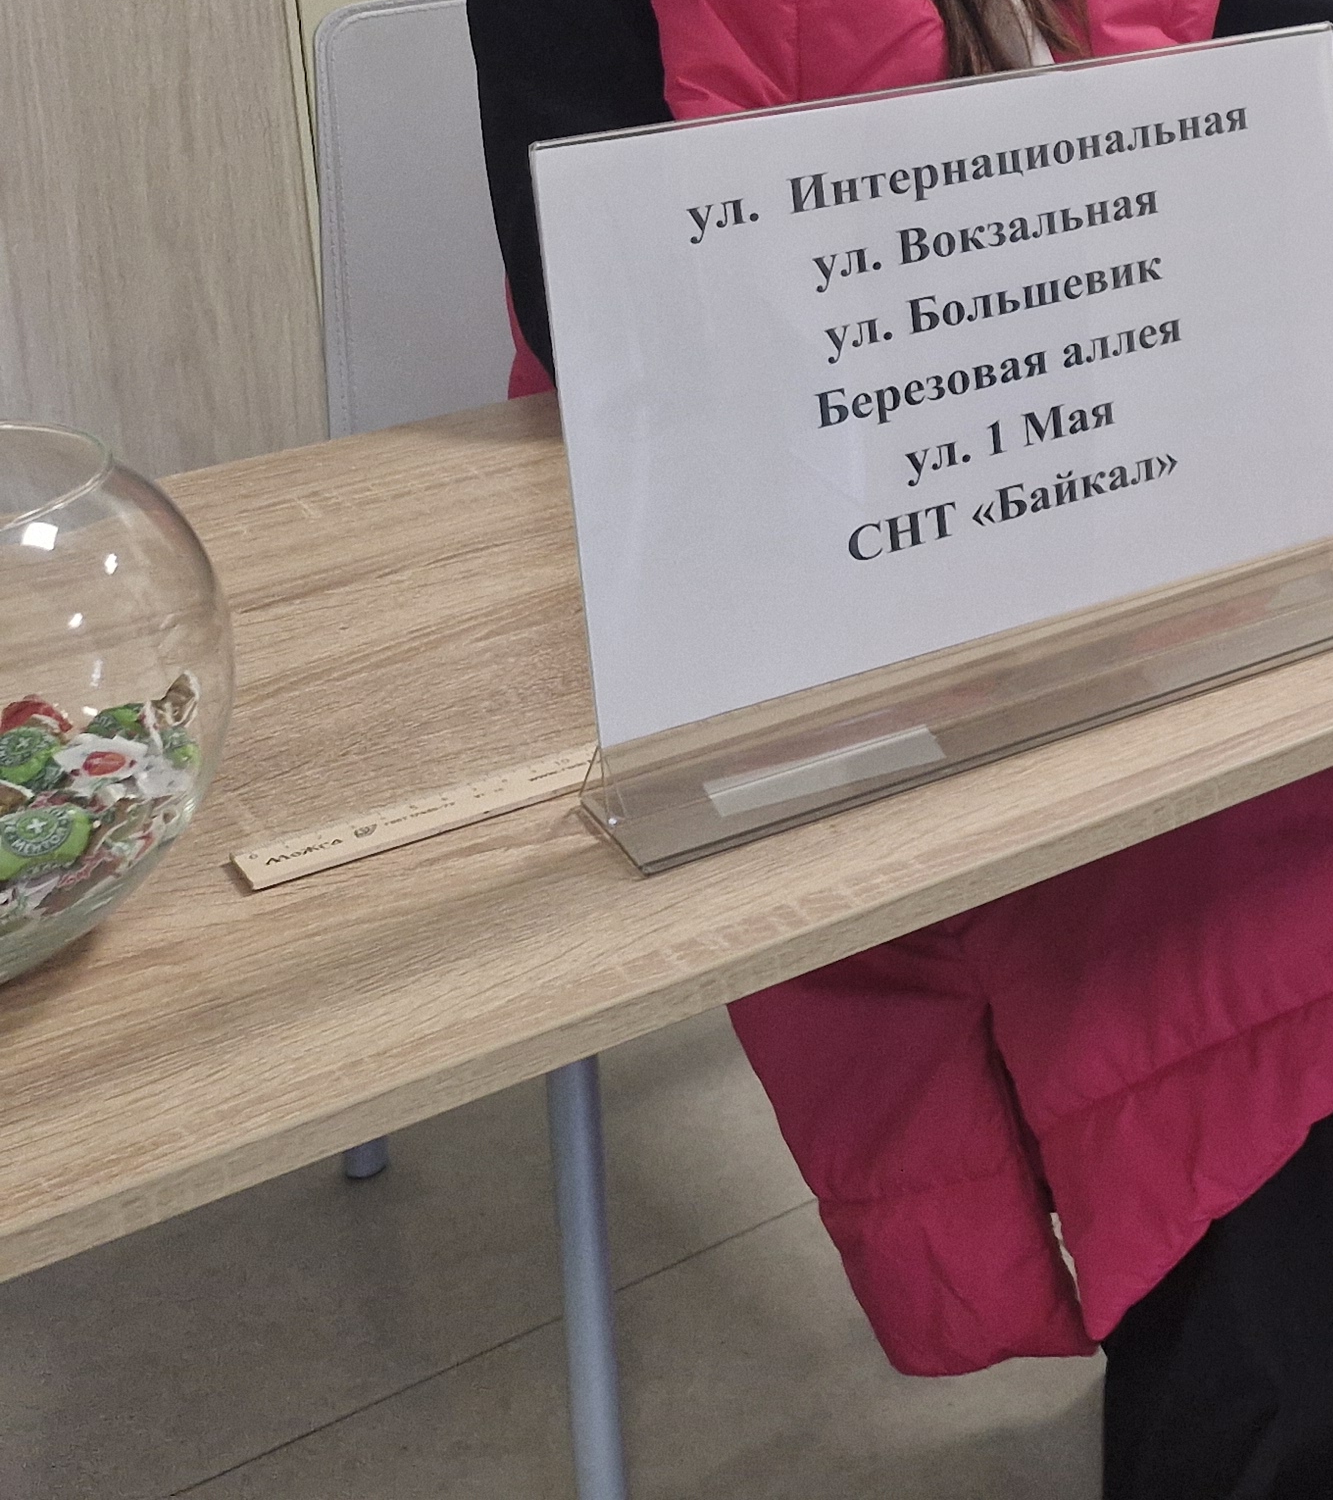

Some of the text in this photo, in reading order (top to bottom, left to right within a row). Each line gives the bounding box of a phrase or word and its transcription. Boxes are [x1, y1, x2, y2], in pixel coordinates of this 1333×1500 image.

[685, 107, 1249, 245] ул. Интернациональная
[811, 190, 1160, 293] ул. Вокзальная
[823, 255, 1164, 365] ул. Большевик
[815, 318, 1183, 429] Березовая аллея
[903, 401, 1116, 488] ул. 1 Мая
[846, 452, 1180, 563] СНТ «Байкал»
